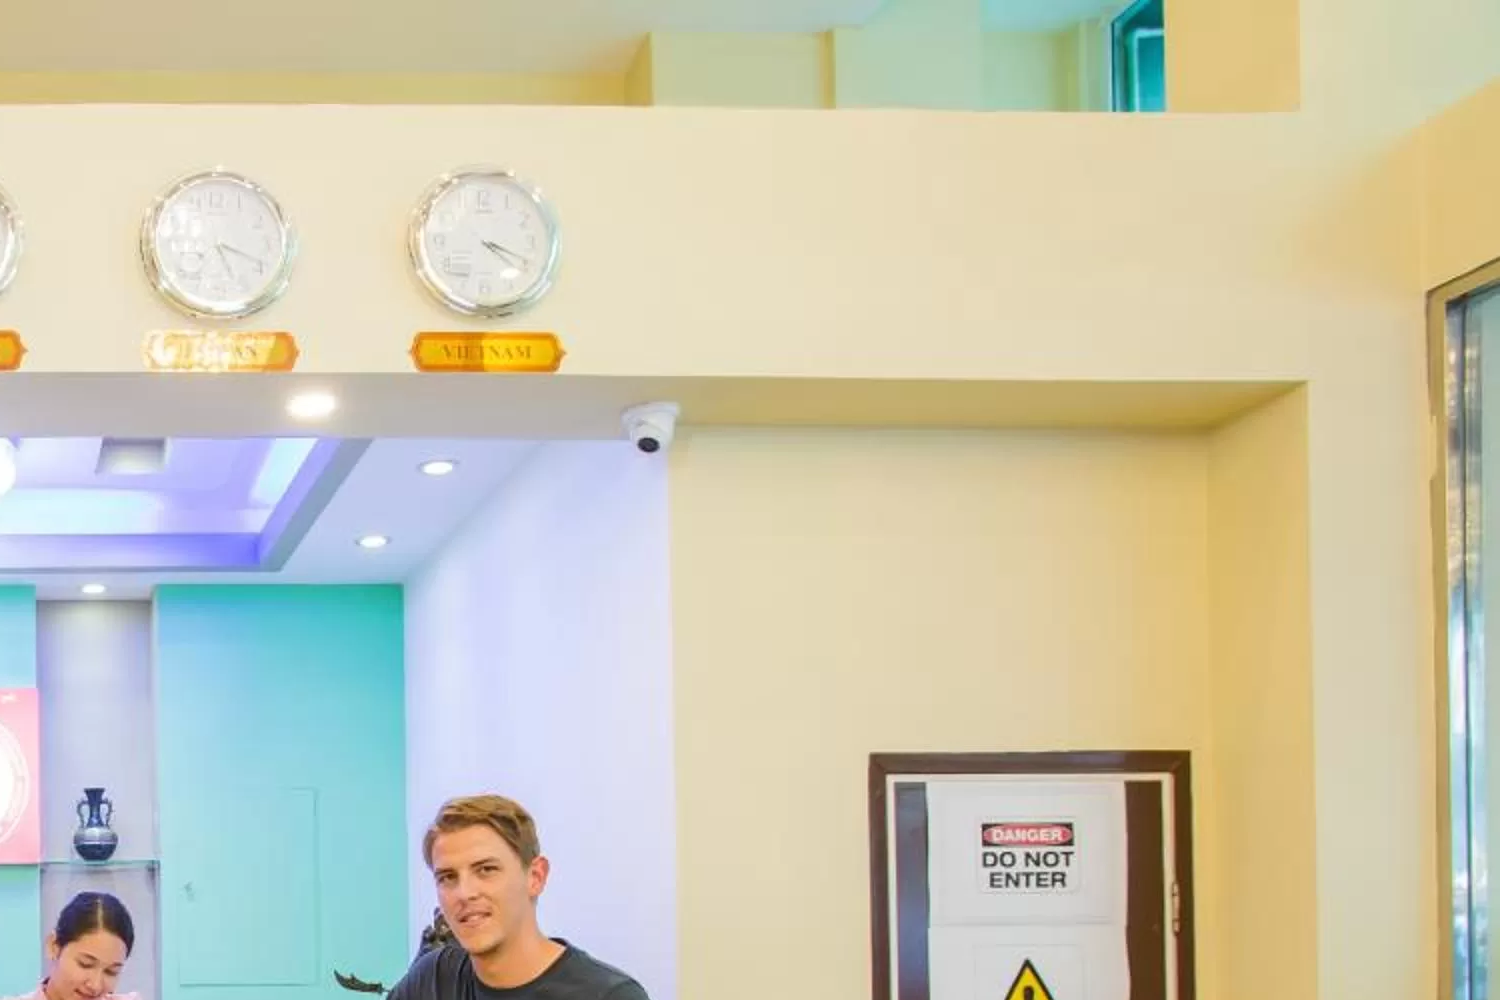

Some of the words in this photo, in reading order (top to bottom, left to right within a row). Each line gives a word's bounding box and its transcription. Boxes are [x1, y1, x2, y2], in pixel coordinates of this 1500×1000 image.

[440, 344, 531, 360] VIETNAM
[992, 827, 1063, 841] DANGER
[982, 851, 1017, 867] DO
[1024, 851, 1075, 867] NOT
[989, 871, 1067, 888] ENTER
